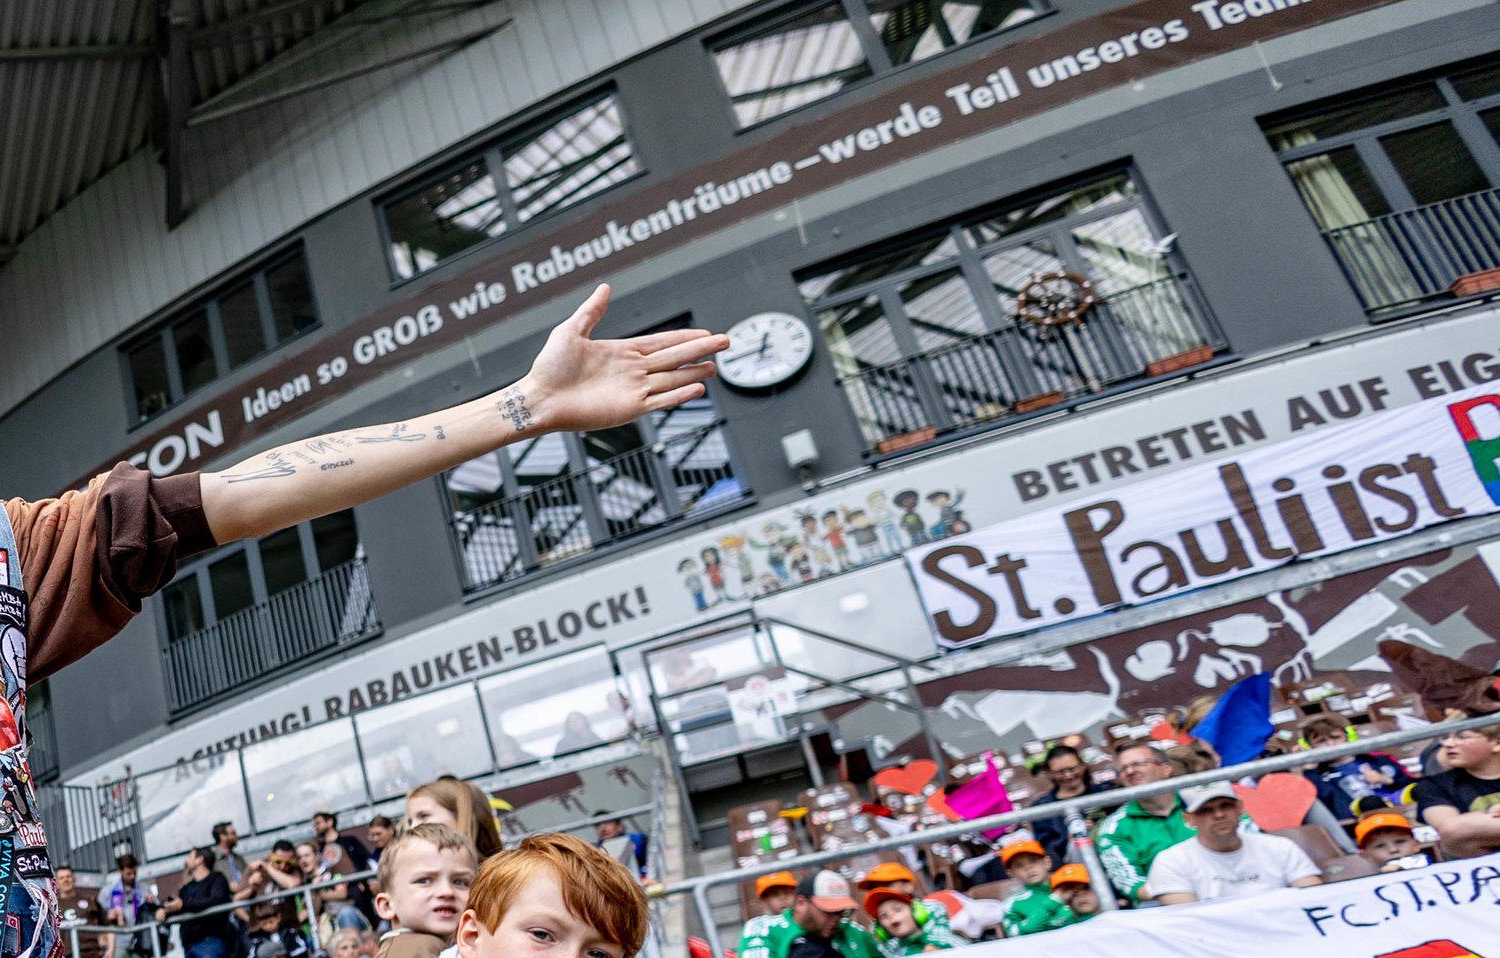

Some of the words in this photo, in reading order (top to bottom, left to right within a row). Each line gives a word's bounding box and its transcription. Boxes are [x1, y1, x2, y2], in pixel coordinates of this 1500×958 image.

[241, 374, 311, 424] Ideen
[316, 352, 349, 386] so
[449, 281, 507, 321] wie
[945, 65, 1021, 117] Teil
[1027, 20, 1189, 90] unseres
[1012, 410, 1266, 502] BETRETEN
[1287, 375, 1390, 432] AUF
[1407, 346, 1500, 400] EIG
[922, 544, 1075, 642] St.
[1063, 462, 1324, 607] Pauli
[1322, 453, 1466, 541] ist
[174, 705, 312, 784] ACHTUNG!
[324, 586, 652, 721] RABAUKEN-BLOCK!
